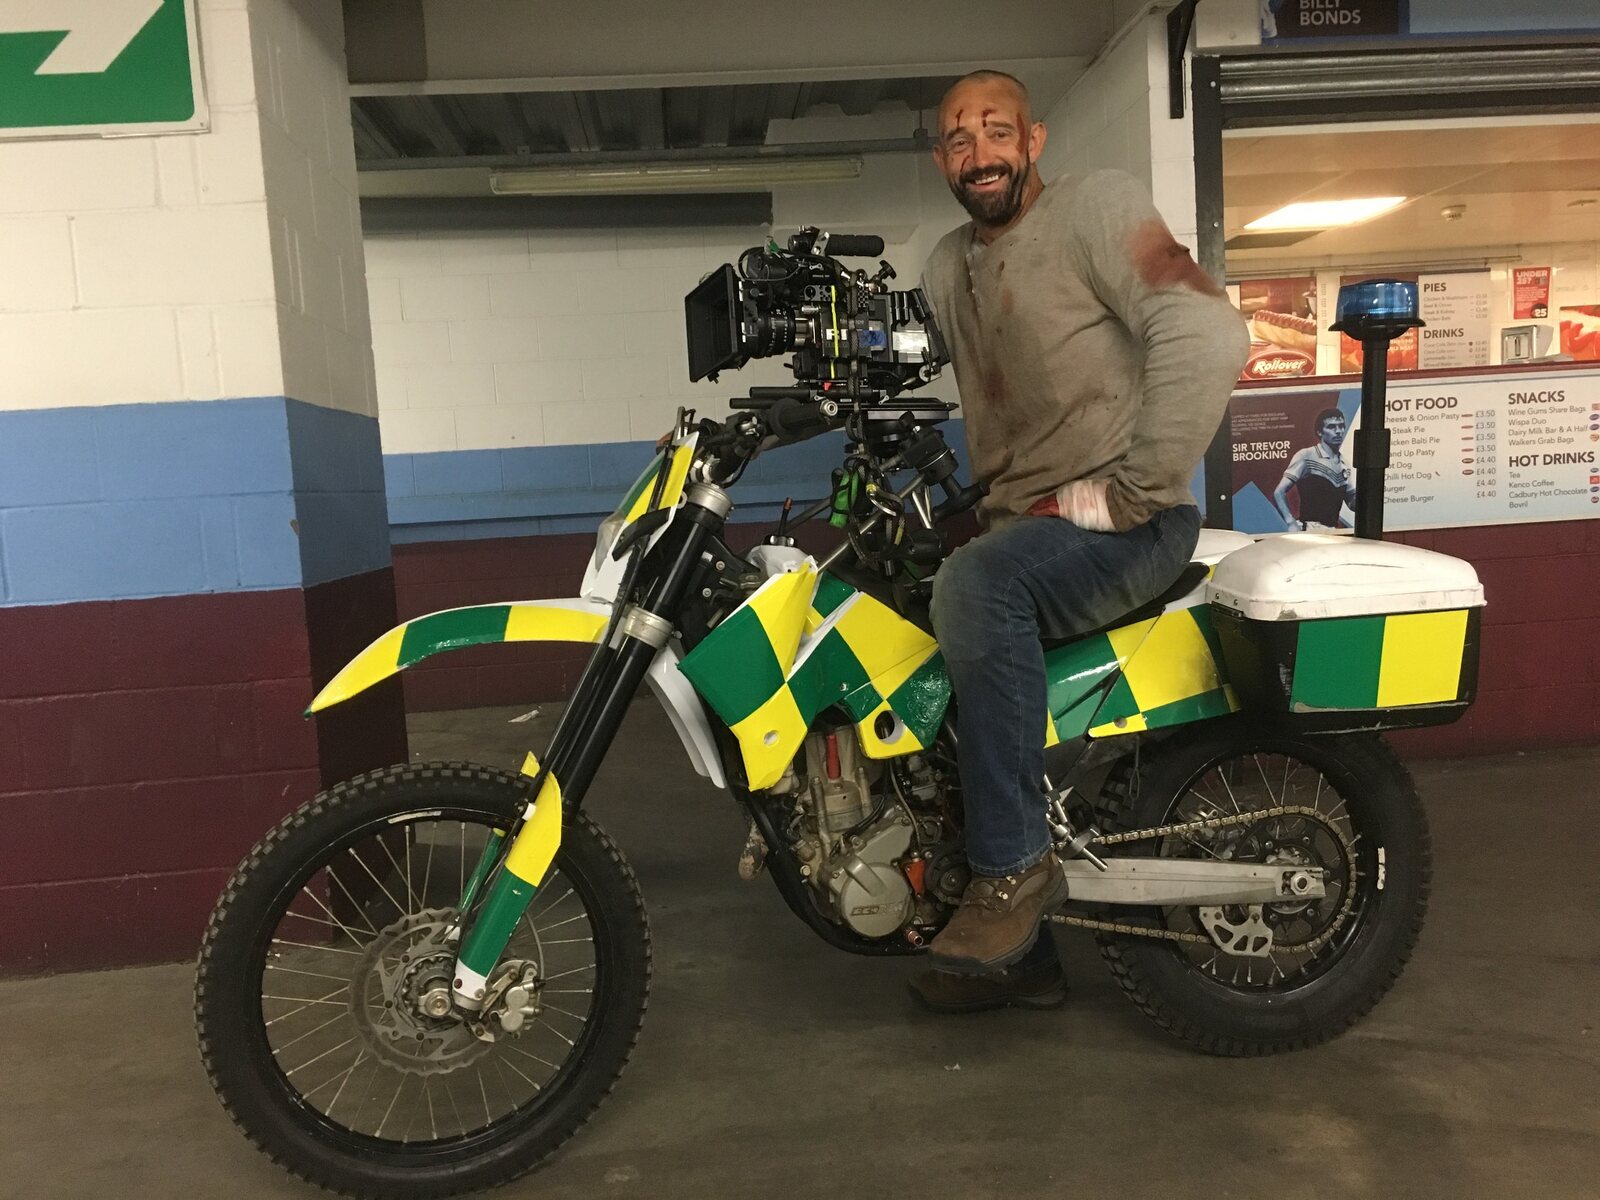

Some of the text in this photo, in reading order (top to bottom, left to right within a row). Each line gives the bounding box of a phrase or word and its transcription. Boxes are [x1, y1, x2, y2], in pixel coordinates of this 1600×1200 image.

[1300, 10, 1361, 26] BONDS
[1424, 282, 1446, 292] PIES
[1534, 308, 1547, 317] 25
[1424, 328, 1464, 339] DRINKS
[1253, 359, 1306, 374] Rollover
[1508, 390, 1565, 404] SNACKS
[1416, 397, 1458, 410] FOOD
[1385, 415, 1406, 423] heese
[1441, 413, 1460, 421] Pasty
[1508, 419, 1529, 427] Wispa
[1233, 440, 1290, 453] SIR TREVOR
[1233, 450, 1288, 462] BROOKING
[1404, 450, 1414, 458] Up
[1416, 449, 1435, 457] Pasty
[1509, 451, 1595, 467] HOT DRINKS
[1416, 472, 1432, 480] Dog
[1410, 495, 1434, 503] Burger
[1509, 491, 1538, 501] Cadbury
[1554, 488, 1588, 496] Chocolate
